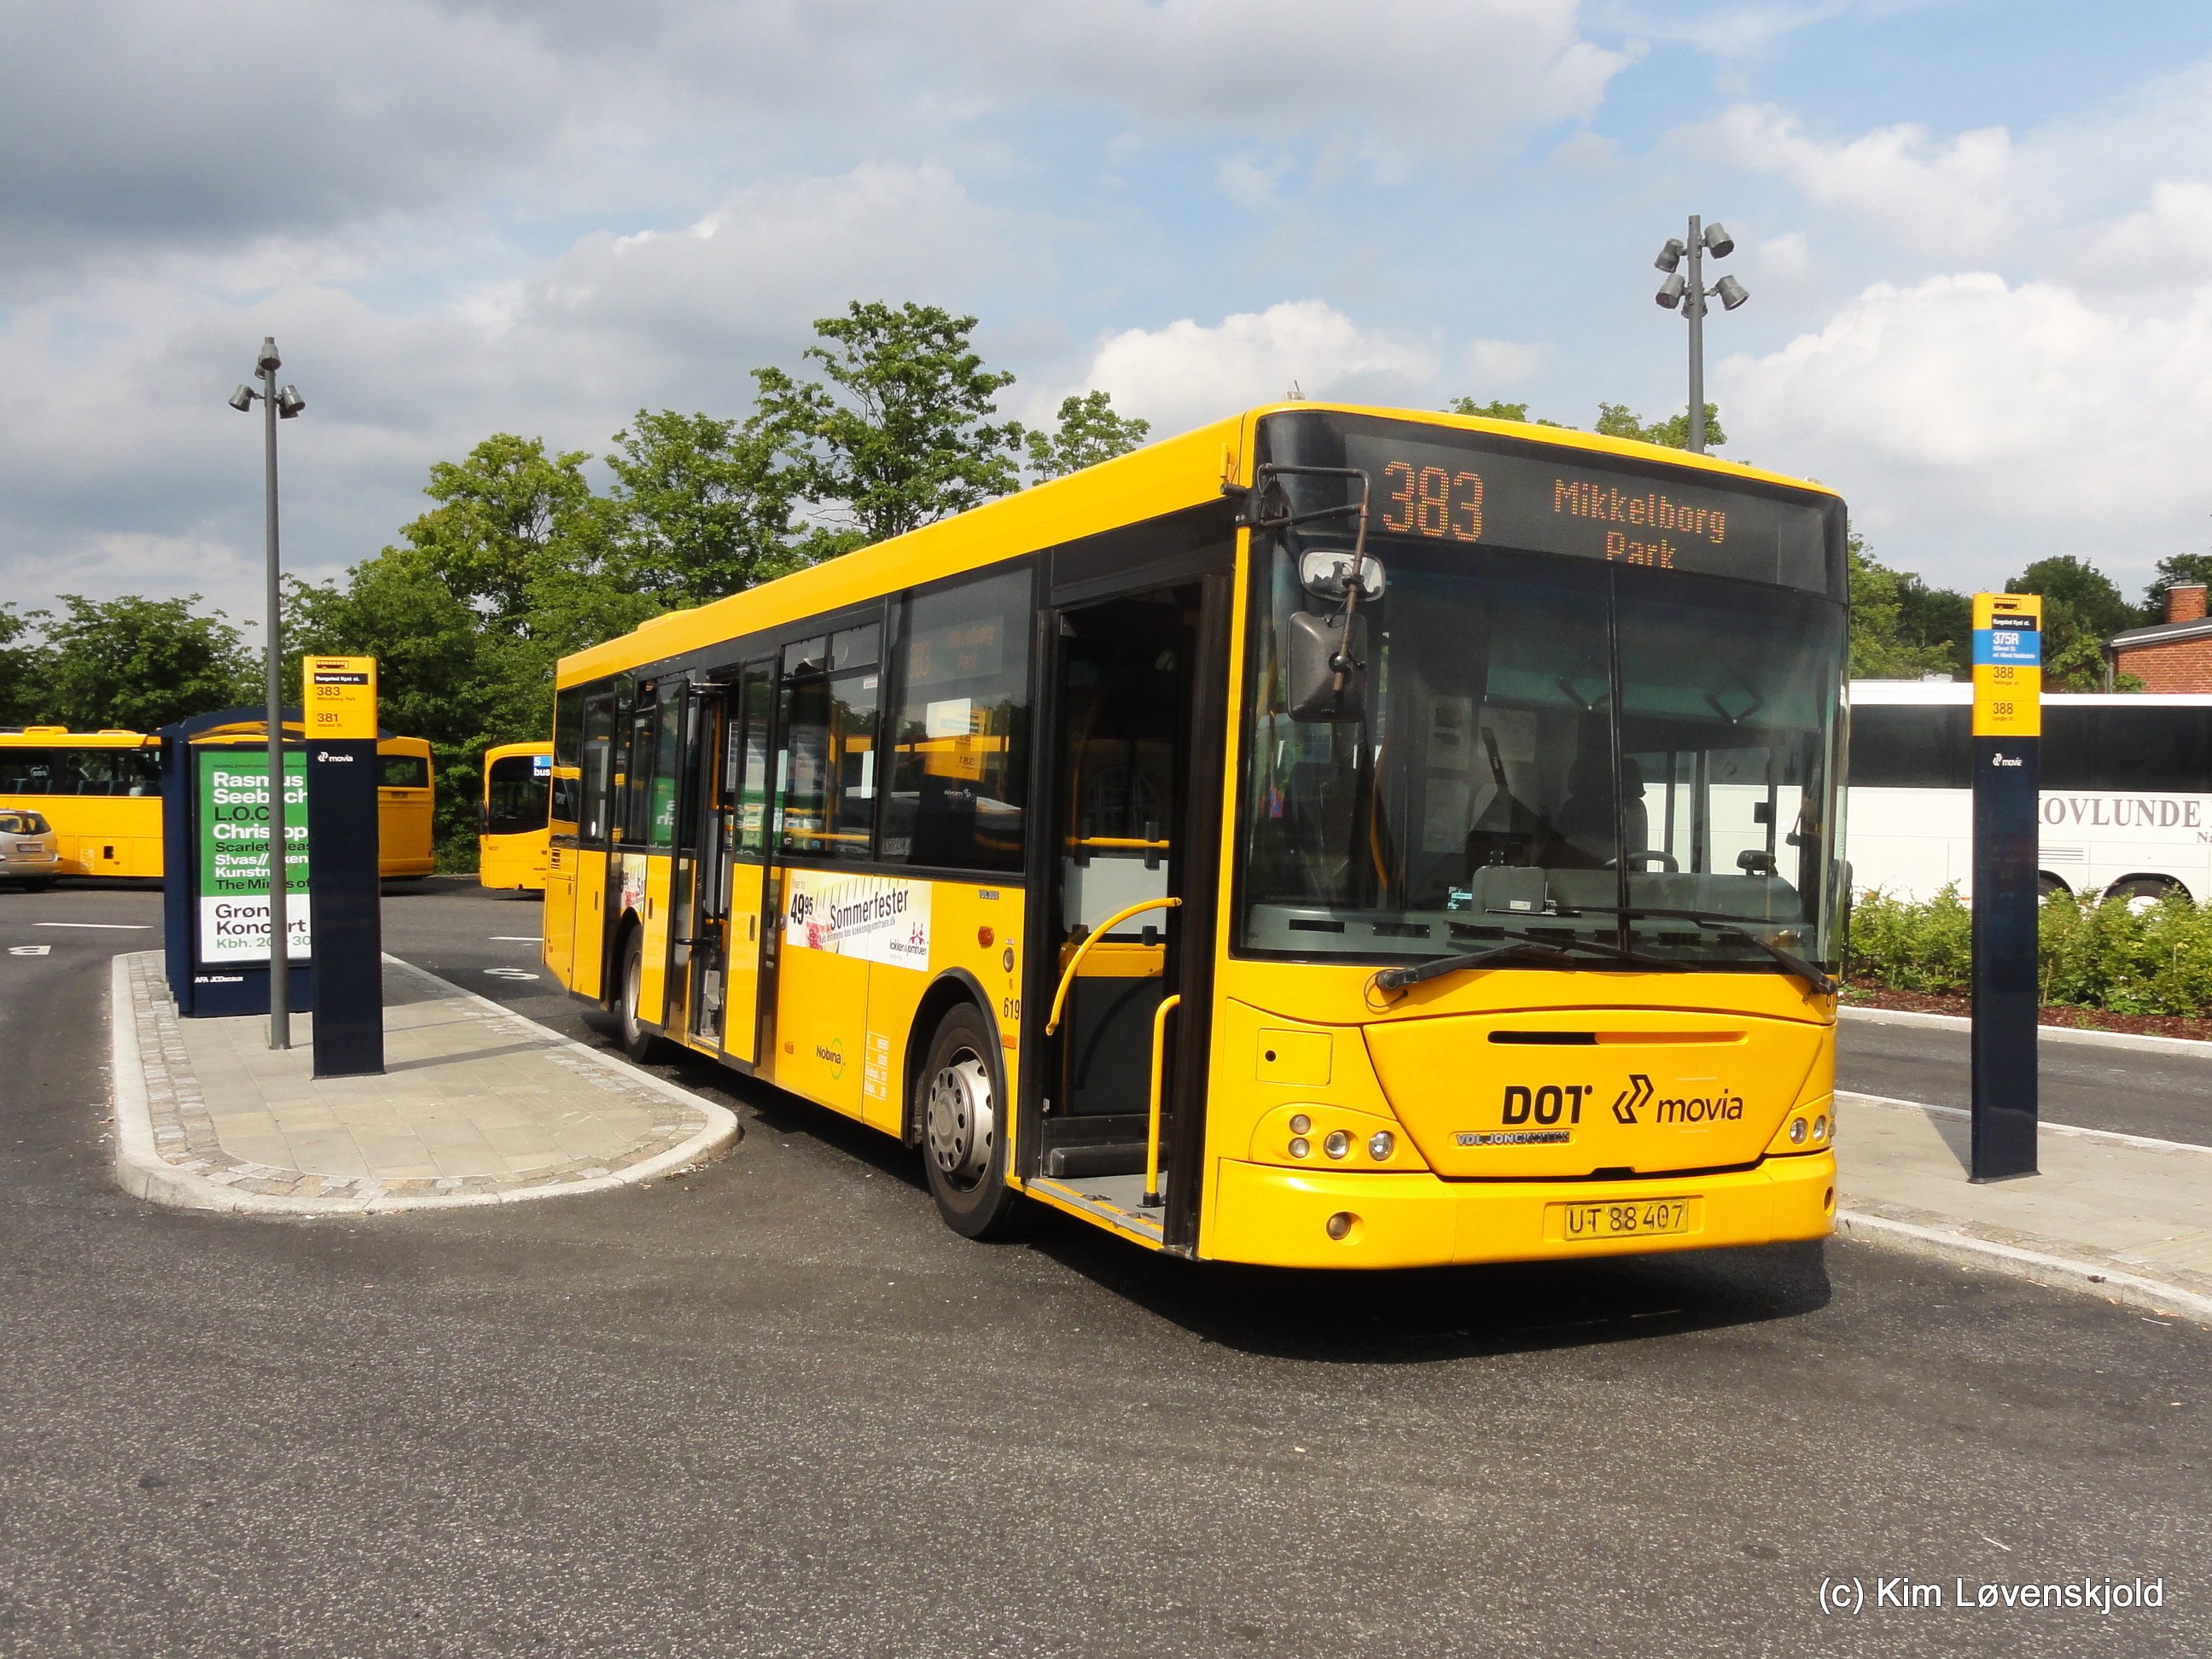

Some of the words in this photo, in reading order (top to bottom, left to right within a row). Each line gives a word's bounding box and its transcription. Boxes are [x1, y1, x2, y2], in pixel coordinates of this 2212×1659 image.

[1382, 460, 1484, 542] 383
[1554, 478, 1726, 544] Mikkelborg
[1605, 530, 1679, 569] Park
[1993, 632, 2019, 645] 375R
[1993, 666, 2014, 679] 388
[317, 686, 341, 696] 383
[1993, 701, 2014, 715] 388
[317, 713, 339, 723] 381
[329, 754, 354, 762] movia
[533, 756, 541, 766] S
[533, 767, 551, 777] bus
[212, 788, 308, 804] Seebch
[2039, 797, 2202, 828] OVLUNDE
[215, 880, 245, 890] The
[830, 887, 909, 931] Sommerfester
[216, 919, 307, 935] Koncrt
[216, 938, 252, 949] Kbh.
[1003, 997, 1021, 1021] 619
[816, 1044, 841, 1065] Nobina
[1501, 1084, 1592, 1126] DOT
[1656, 1088, 1744, 1124] movia
[1456, 1132, 1482, 1146] VDL
[1569, 1208, 1601, 1234] UT
[1610, 1206, 1638, 1232] 88
[1642, 1204, 1685, 1231] 407
